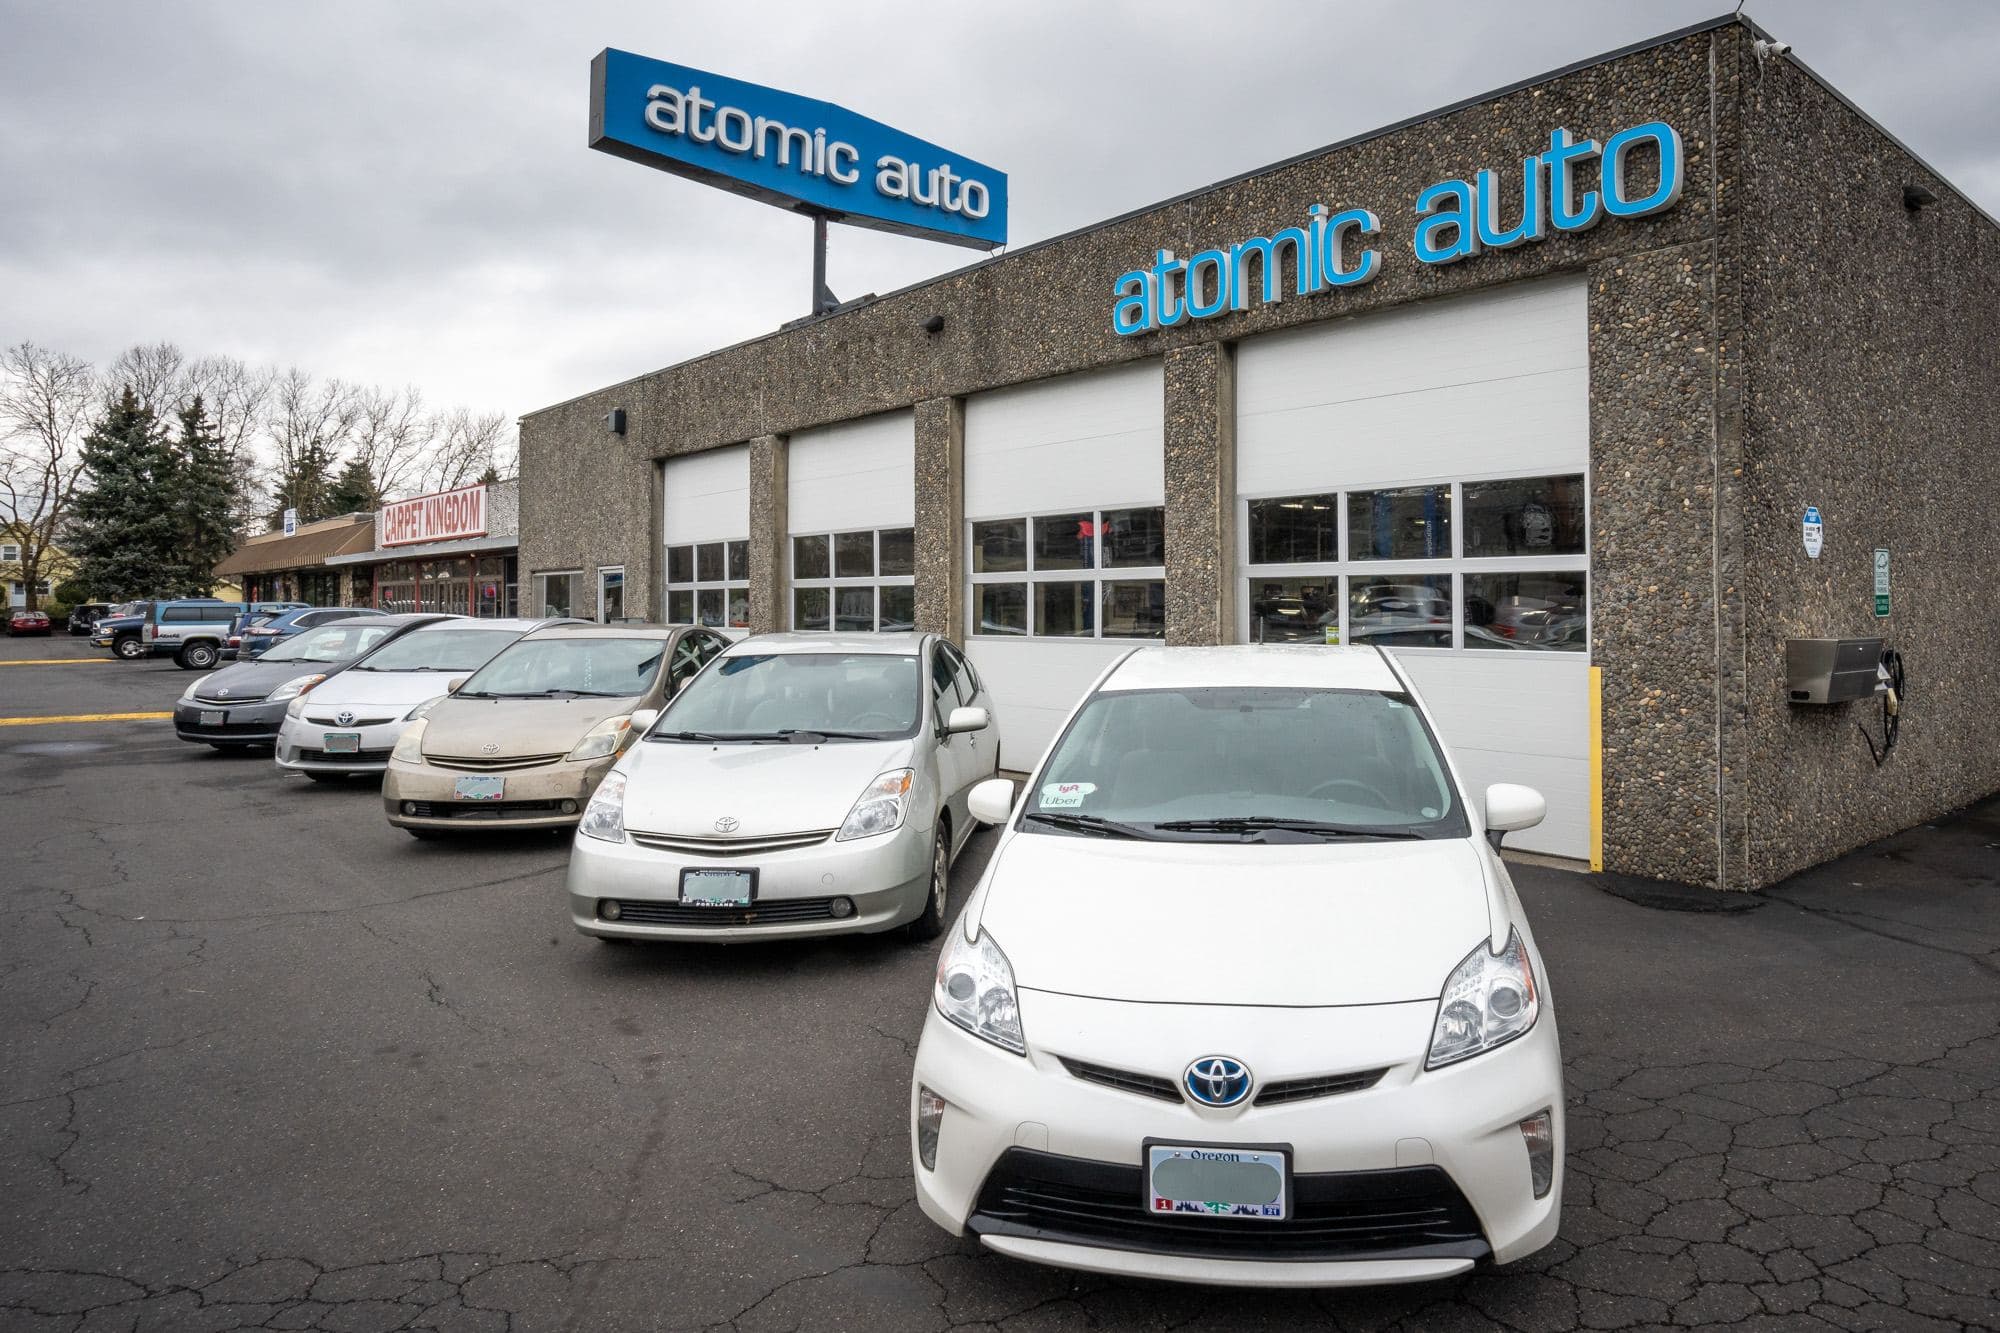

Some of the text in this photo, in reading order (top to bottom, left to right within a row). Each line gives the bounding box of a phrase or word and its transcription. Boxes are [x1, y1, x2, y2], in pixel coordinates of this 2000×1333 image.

[645, 84, 989, 219] atomic auto
[1113, 121, 1683, 336] atomic auto
[385, 490, 480, 542] CARPET KINGDOM
[1045, 796, 1078, 805] Uber
[1191, 1150, 1240, 1163] Oregon
